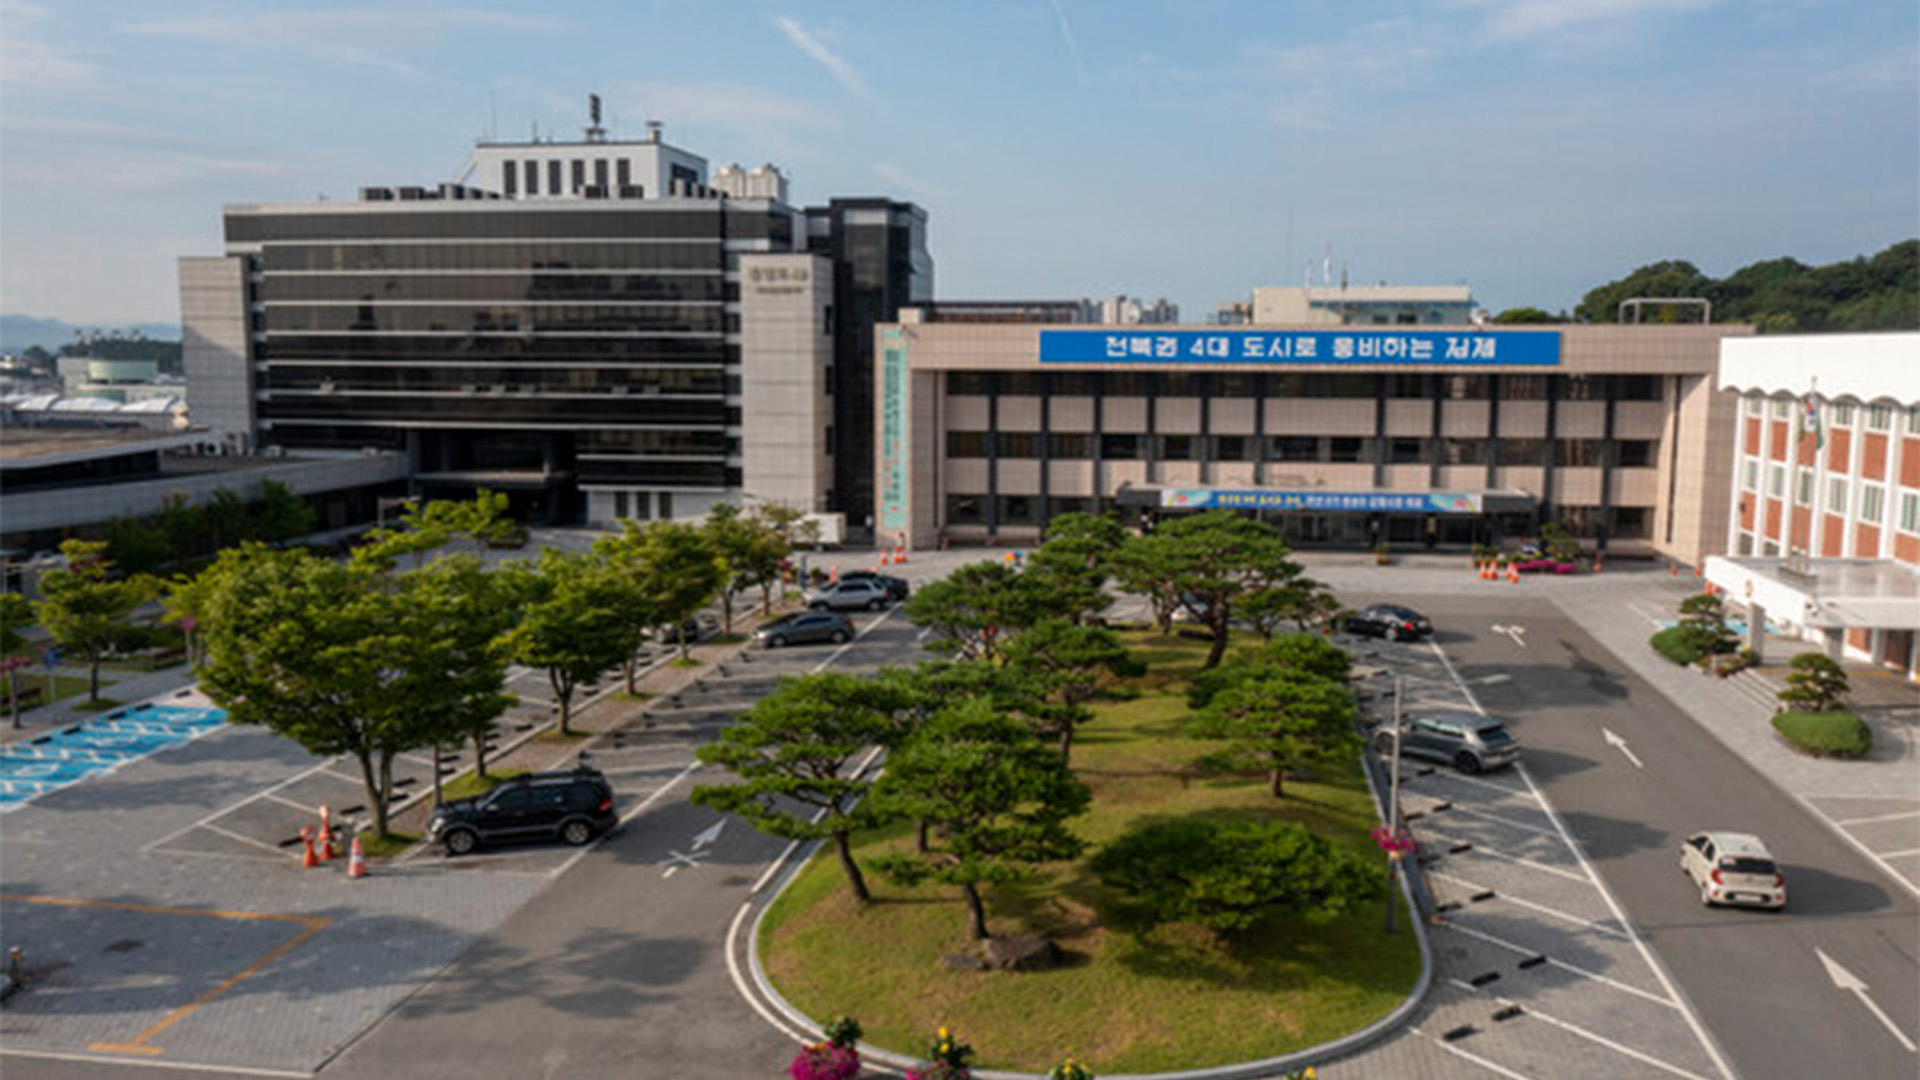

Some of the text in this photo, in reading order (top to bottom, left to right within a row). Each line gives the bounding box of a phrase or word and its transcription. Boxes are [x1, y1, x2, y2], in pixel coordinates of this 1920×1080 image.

[1106, 336, 1178, 358] 전북권
[1190, 336, 1230, 358] 4대
[1242, 336, 1318, 358] 도시로
